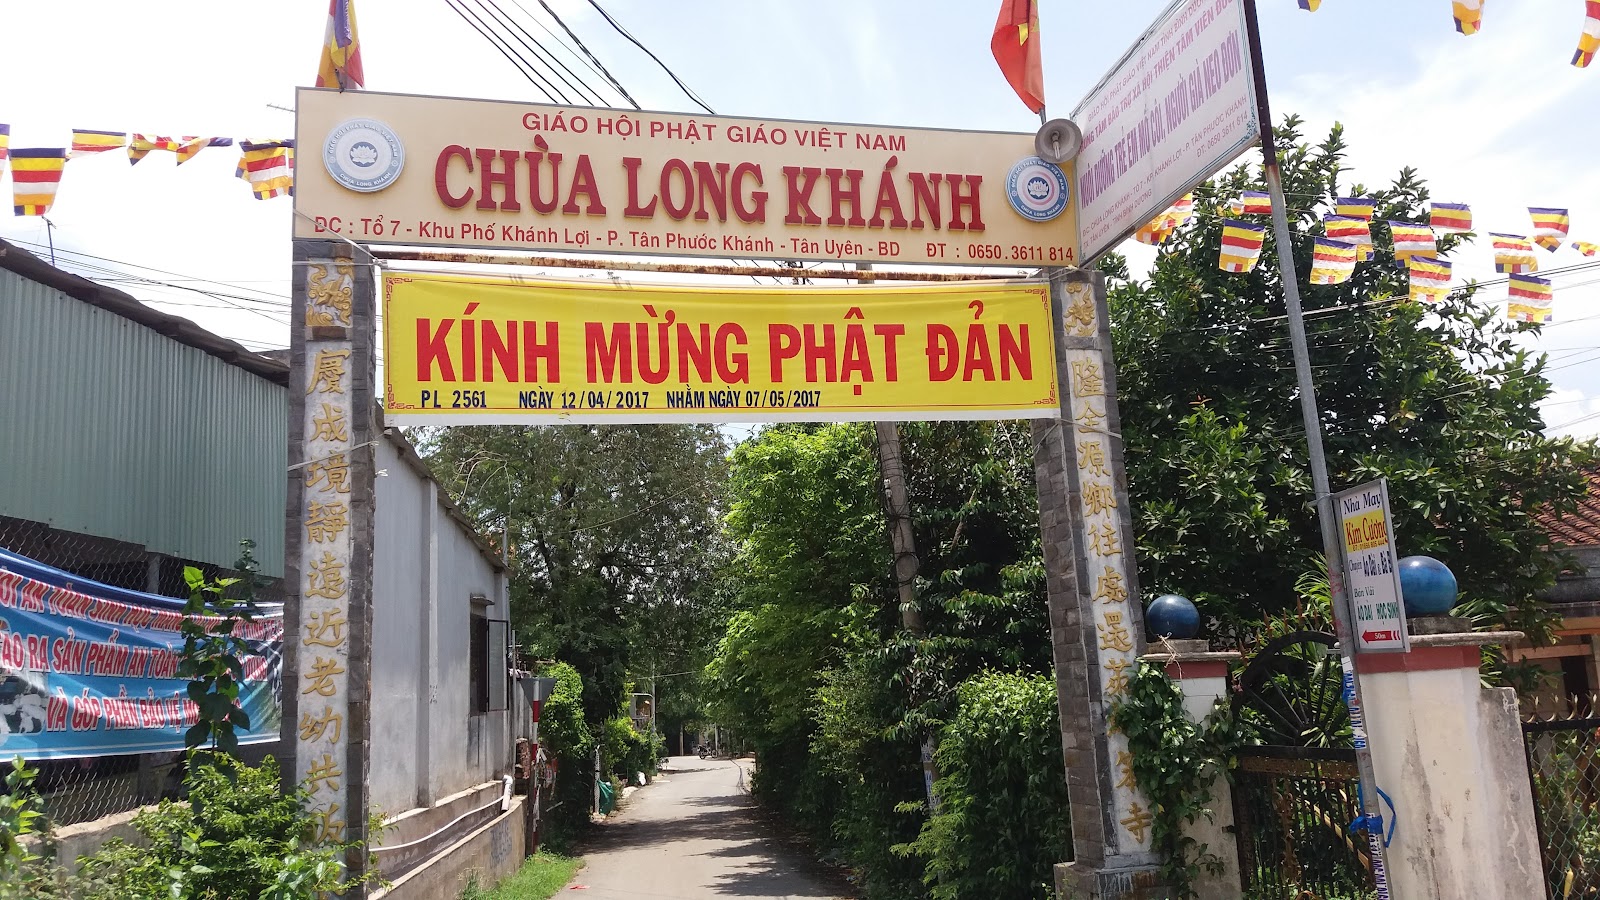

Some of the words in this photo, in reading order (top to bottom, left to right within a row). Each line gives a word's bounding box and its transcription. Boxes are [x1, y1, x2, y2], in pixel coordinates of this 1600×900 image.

[1147, 41, 1160, 60] NAM
[1176, 27, 1194, 55] TÂM
[1127, 127, 1139, 169] EM
[1203, 48, 1222, 100] NEO
[522, 110, 588, 134] GIÁO
[597, 114, 641, 141] HỘI
[650, 119, 717, 145] PHẬT
[727, 123, 787, 146] GIÁO
[794, 127, 847, 152] VIỆT
[856, 133, 906, 152] NAM
[434, 133, 607, 217] CHÙA
[623, 157, 769, 224] LONG
[781, 155, 986, 232] KHÁNH
[361, 214, 384, 236] Tổ
[390, 220, 400, 236] 7
[419, 221, 454, 239] Khu
[461, 222, 496, 241] Phố
[502, 225, 558, 244] Khánh
[564, 228, 590, 248] Lợi
[608, 230, 624, 246] P.
[629, 231, 660, 248] Tân
[666, 232, 717, 250] Phước
[723, 235, 774, 252] Khánh
[790, 238, 819, 254] Tân
[825, 239, 863, 258] Uyên
[878, 241, 900, 257] BD
[926, 242, 946, 258] ĐT
[1049, 247, 1073, 261] 814
[416, 302, 560, 383] KÍNH
[584, 304, 749, 385] MỪNG
[768, 307, 905, 396] PHẬT
[925, 300, 1033, 382] ĐẢN
[453, 390, 487, 409] 2561
[519, 385, 554, 410] NGÀY
[667, 384, 705, 410] NHẰM
[709, 385, 741, 409] NGÀY
[745, 390, 821, 409] 07/05/2017
[1343, 495, 1360, 515] Nhà
[1363, 491, 1381, 508] May
[1346, 521, 1362, 546] Kim
[20, 577, 49, 614] AN
[0, 632, 25, 676] ẠO
[27, 634, 51, 673] RA
[52, 626, 87, 674] SẢN
[85, 627, 130, 677] PHẨM
[126, 645, 149, 679] AN
[45, 686, 67, 732] VÀ
[71, 687, 102, 731] GÓP
[104, 684, 141, 731] PHẦN
[139, 687, 166, 729] BẢO
